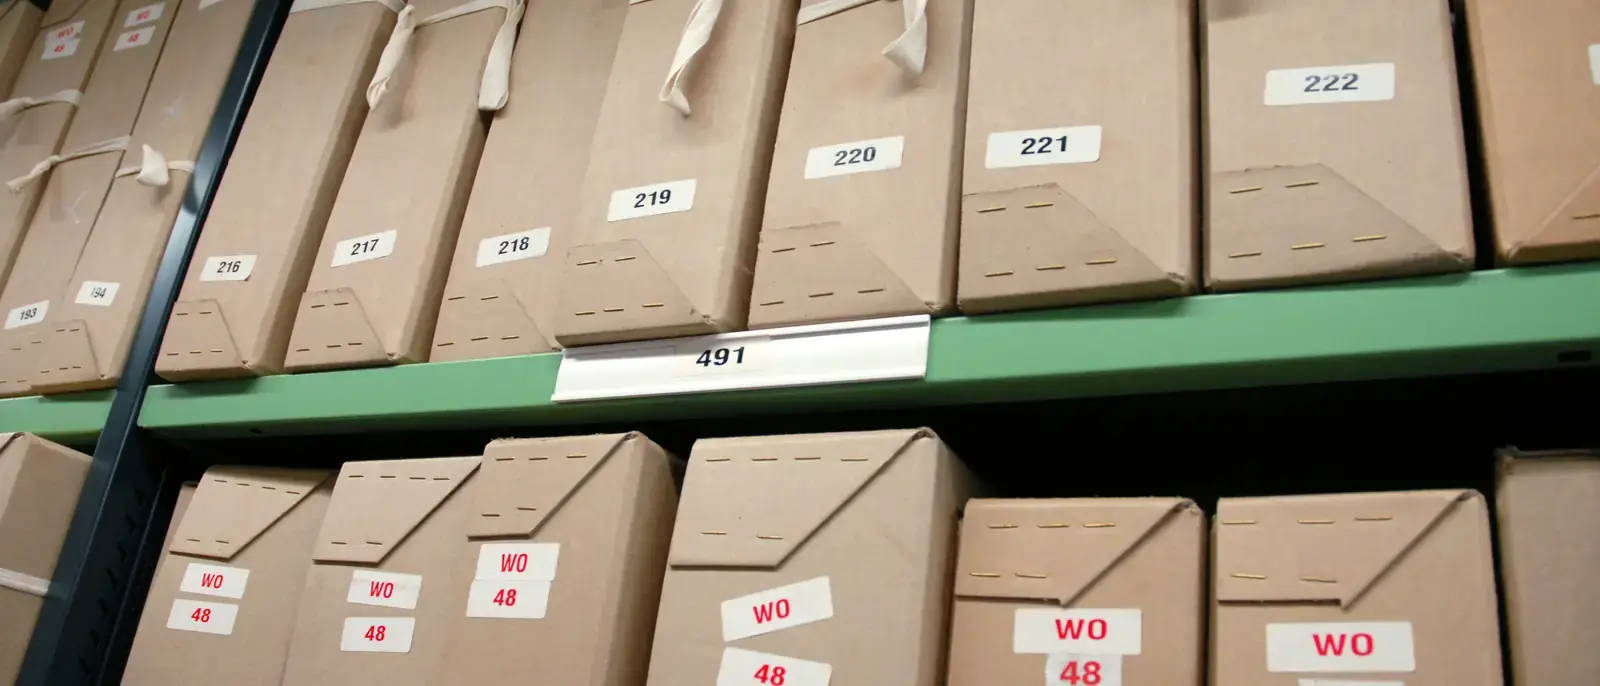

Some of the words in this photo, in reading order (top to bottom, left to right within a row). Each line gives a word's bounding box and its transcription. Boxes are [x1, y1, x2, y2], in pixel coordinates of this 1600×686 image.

[1303, 73, 1359, 93] 222
[1020, 135, 1068, 156] 221
[833, 146, 877, 167] 220
[633, 189, 672, 209] 219
[350, 238, 380, 256] 217
[498, 236, 531, 255] 218
[216, 260, 242, 274] 216
[90, 286, 107, 299] 194
[20, 307, 38, 321] 193
[695, 346, 746, 367] 491
[501, 552, 529, 574] WO
[200, 573, 225, 590] WO
[370, 580, 395, 599] WO
[492, 588, 518, 607] 48
[191, 607, 212, 623] 48
[753, 598, 791, 624] WO
[365, 625, 387, 642] 48
[1055, 618, 1108, 641] WO
[1312, 632, 1375, 657] WO
[753, 664, 786, 686] 48
[1060, 660, 1102, 686] 48
